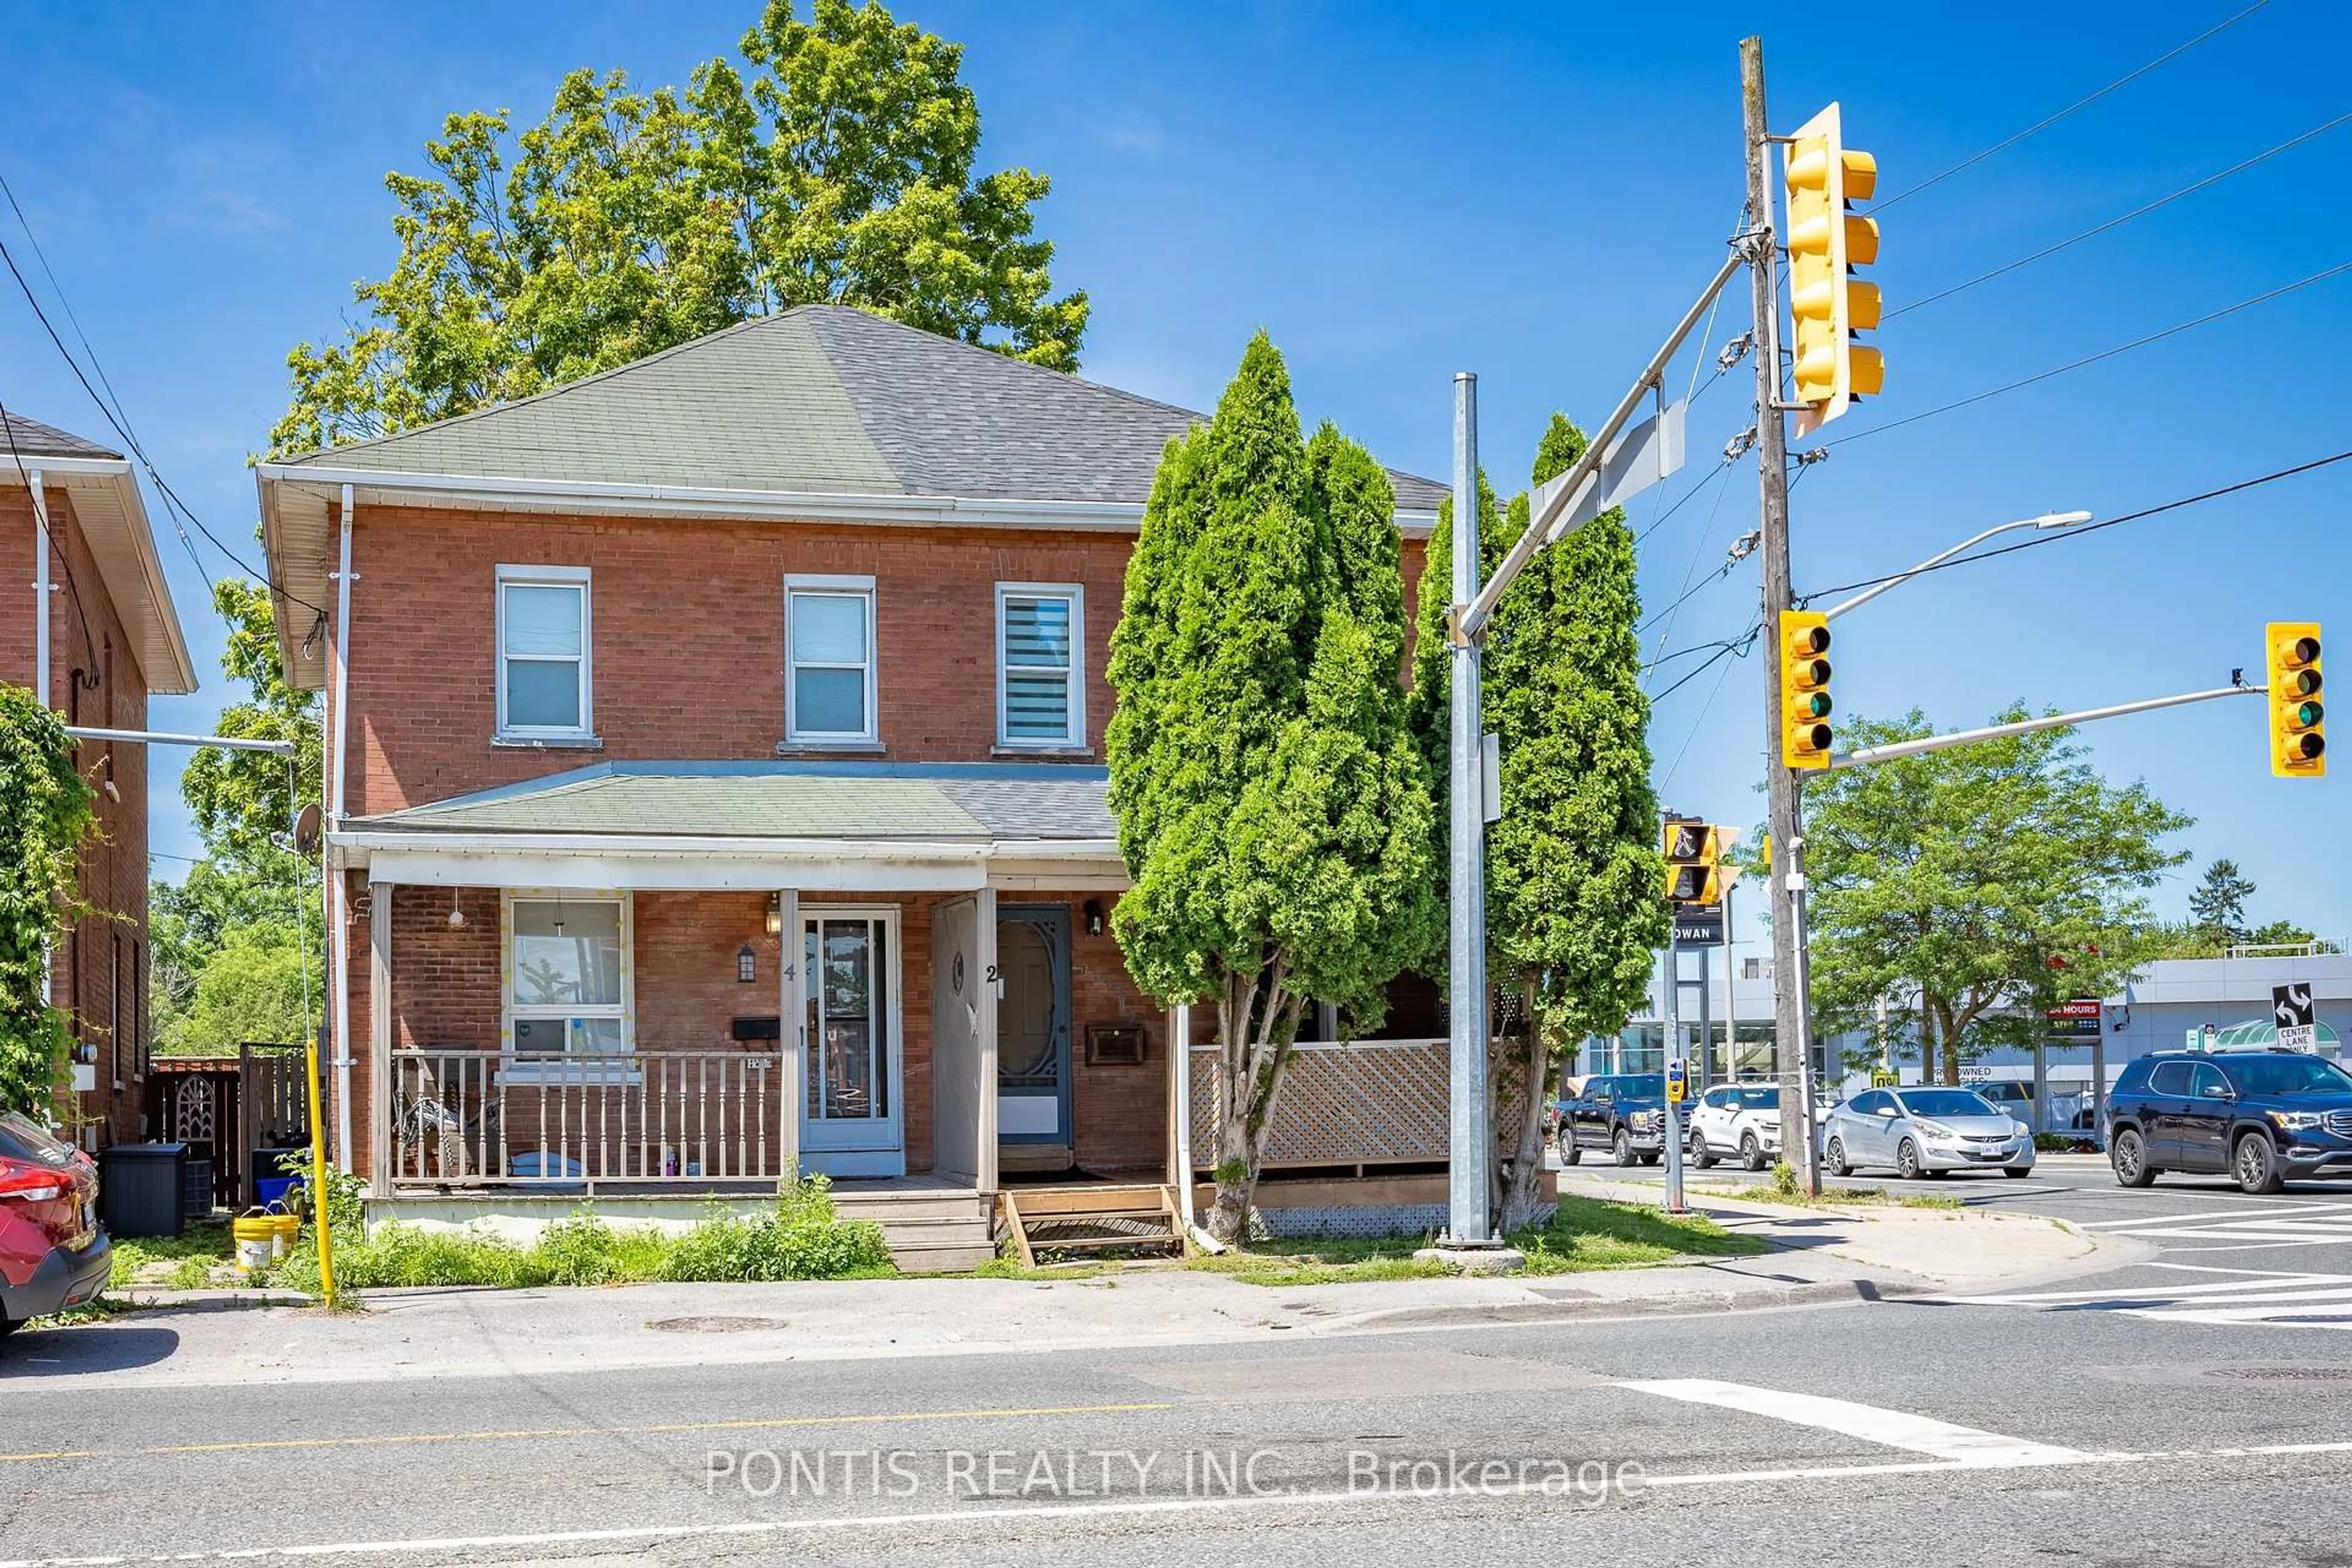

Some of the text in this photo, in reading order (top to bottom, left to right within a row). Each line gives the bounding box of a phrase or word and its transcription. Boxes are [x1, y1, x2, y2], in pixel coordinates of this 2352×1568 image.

[1675, 928, 1709, 938] OWAN
[784, 963, 796, 981] 4
[987, 965, 997, 982] 2
[2063, 1005, 2097, 1014] HOURS
[2281, 1027, 2312, 1038] CENTRE
[2286, 1036, 2308, 1046] LANE
